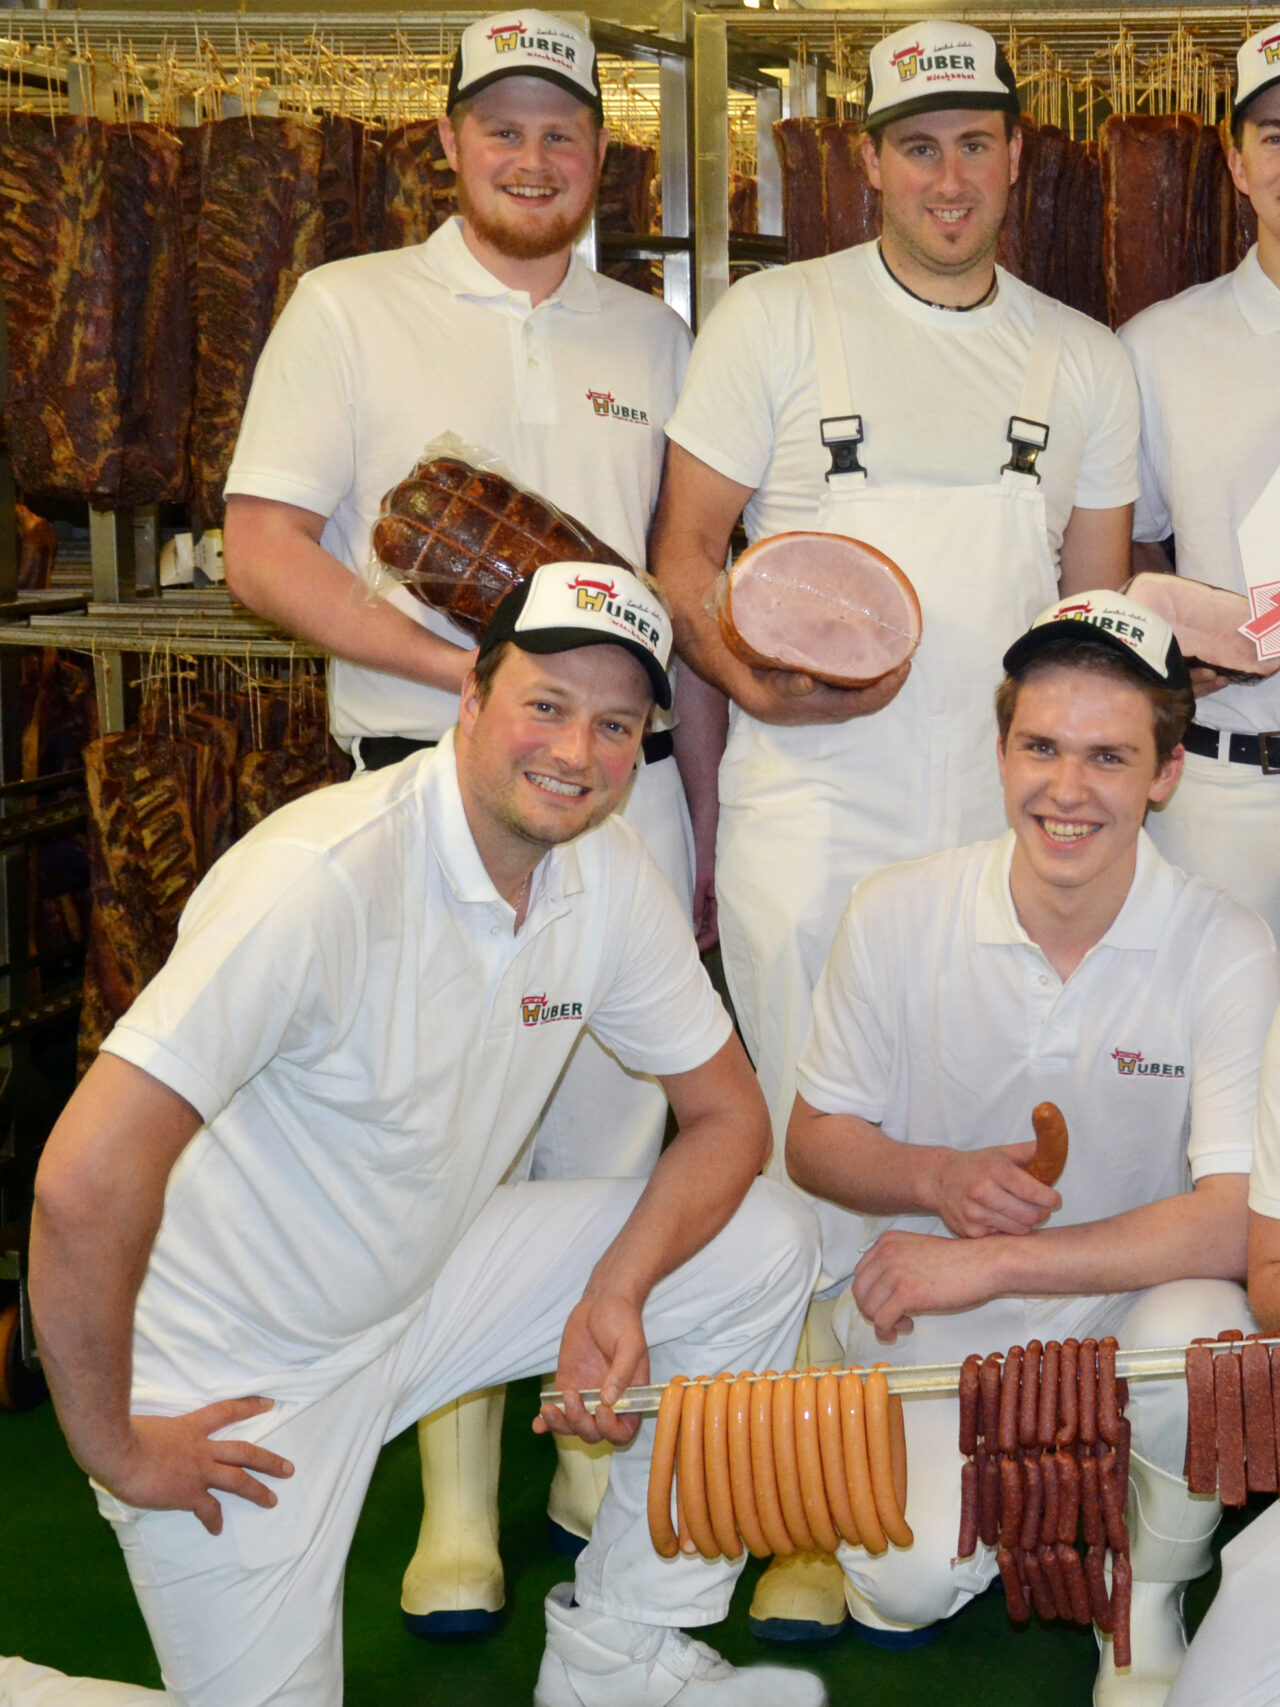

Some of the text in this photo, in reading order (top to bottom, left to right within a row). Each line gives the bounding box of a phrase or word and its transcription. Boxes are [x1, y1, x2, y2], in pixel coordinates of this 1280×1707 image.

[494, 32, 576, 63] HUBER
[897, 55, 976, 79] HUBER
[592, 397, 649, 423] HUBER
[577, 588, 660, 648] HUBER
[522, 1002, 583, 1023] HUBER
[1117, 1057, 1185, 1075] HUBER
